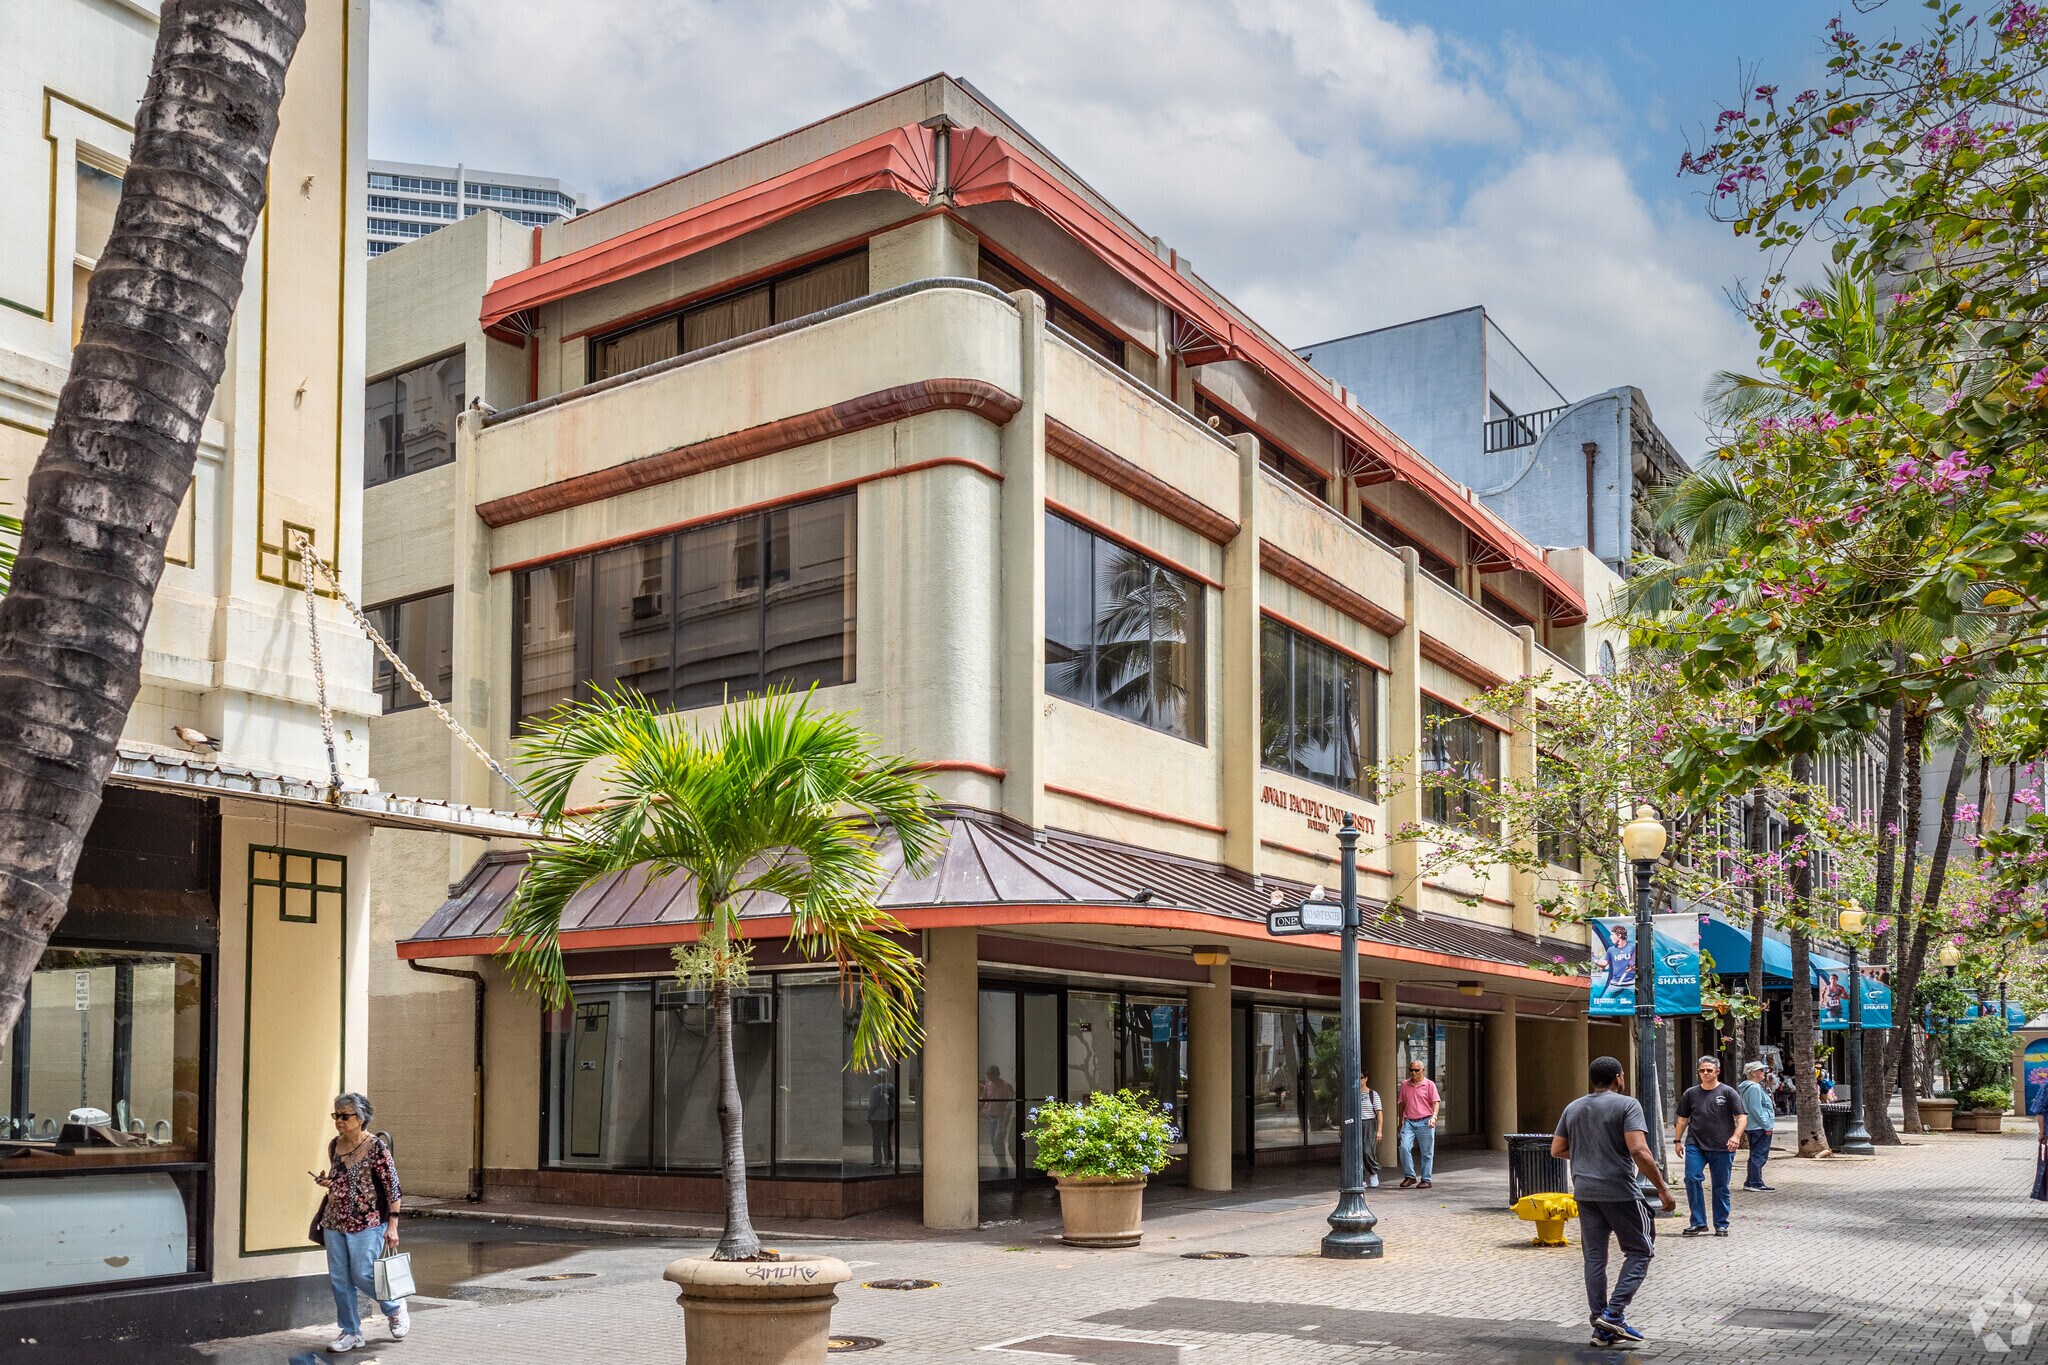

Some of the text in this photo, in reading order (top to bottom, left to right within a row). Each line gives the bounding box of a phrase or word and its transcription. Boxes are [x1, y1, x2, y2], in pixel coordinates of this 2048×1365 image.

[1261, 785, 1376, 834] AWAII PACIFIC UNIRSITY
[1304, 909, 1312, 919] DO
[1325, 911, 1340, 920] ENTER
[1277, 916, 1297, 926] ONE
[1614, 953, 1631, 961] HPU
[1658, 977, 1696, 985] SHARKS
